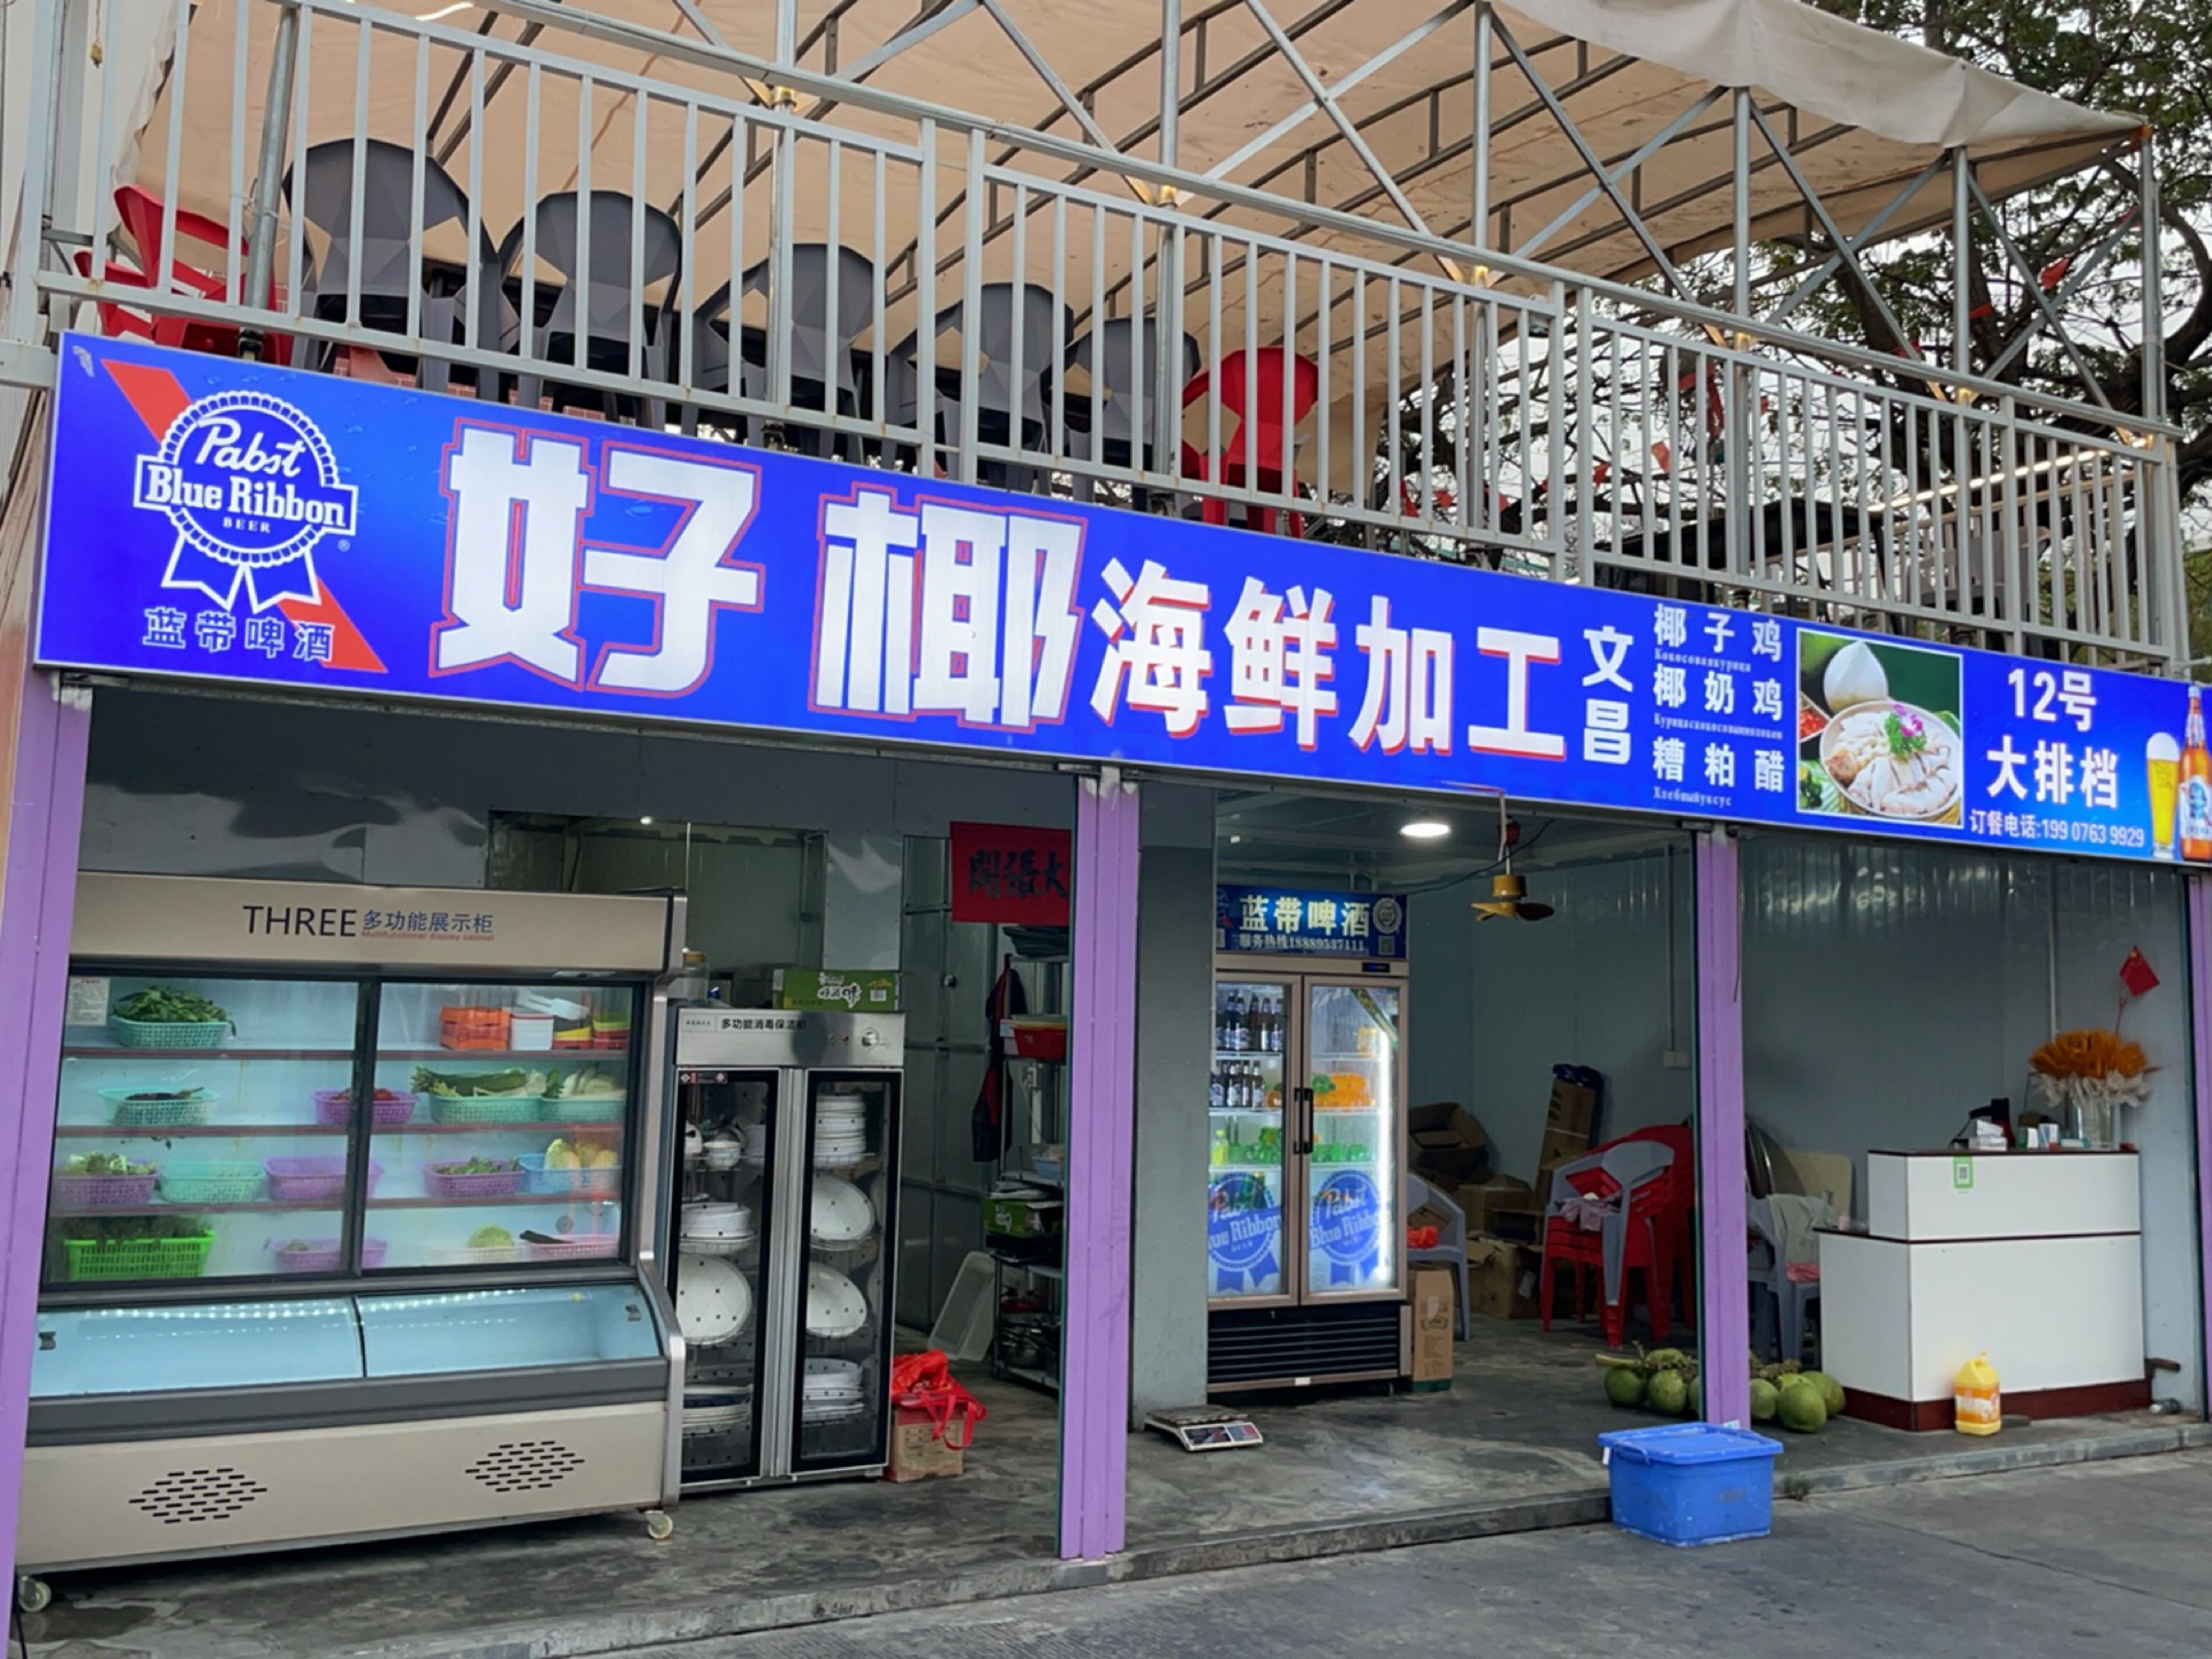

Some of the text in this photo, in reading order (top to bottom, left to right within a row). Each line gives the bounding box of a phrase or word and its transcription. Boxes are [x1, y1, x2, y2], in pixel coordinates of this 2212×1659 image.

[197, 417, 306, 477] Pabst
[146, 464, 346, 527] Blue Ribbon
[223, 517, 271, 534] BEER
[142, 605, 335, 662] 蓝带啤酒
[1653, 603, 1783, 662] 椰子鸡
[1582, 625, 1633, 765] 文昌
[1653, 663, 1783, 721] 椰奶鸡
[2008, 668, 2097, 732] 12号
[1653, 736, 1784, 793] 糟粕醋
[1986, 734, 2119, 809] 大排档
[2071, 821, 2106, 844] 0763
[2110, 824, 2145, 848] 9929
[243, 904, 493, 937] THREE 多功能展示柜
[1239, 895, 1370, 937] 蓝带啤酒
